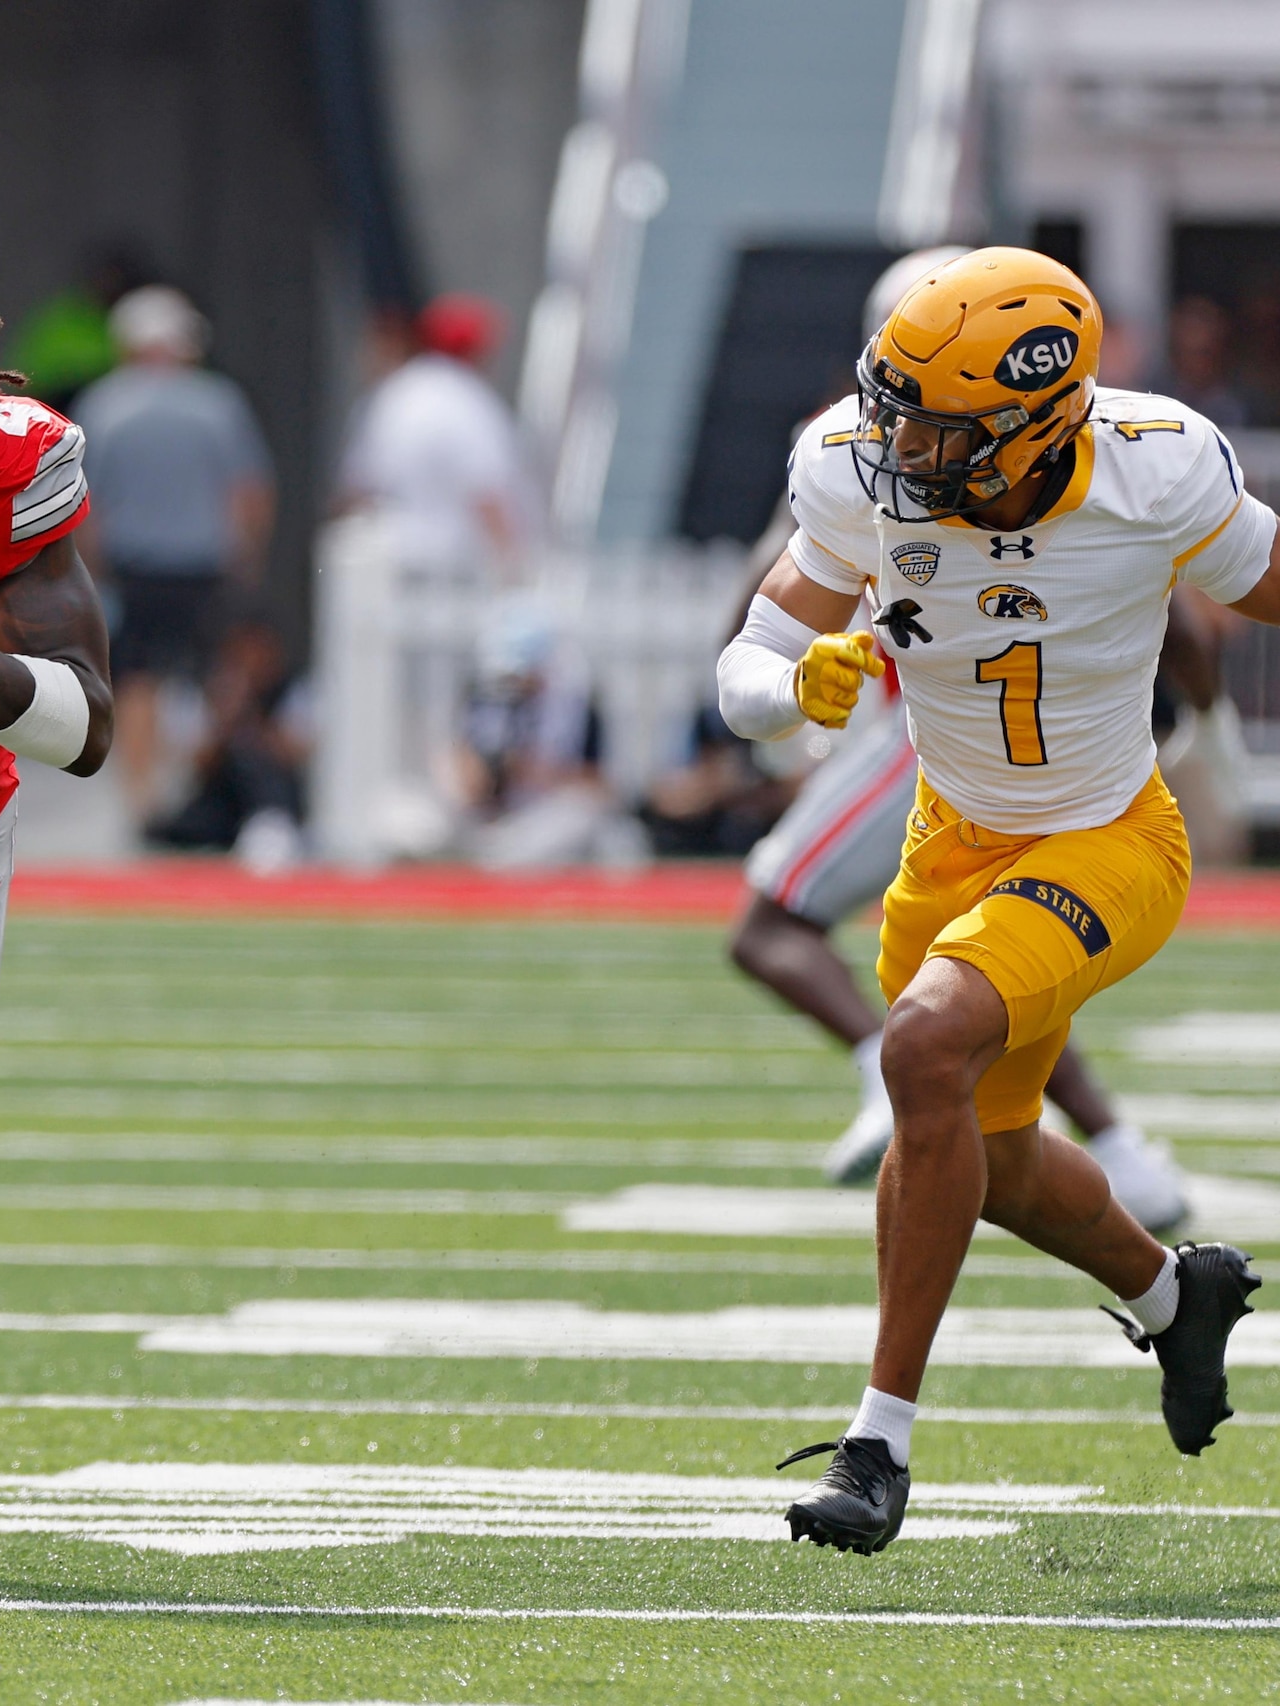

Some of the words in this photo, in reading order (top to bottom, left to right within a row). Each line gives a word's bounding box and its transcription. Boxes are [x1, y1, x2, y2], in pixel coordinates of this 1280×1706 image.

[1006, 336, 1073, 381] KSU
[1114, 420, 1185, 443] 1
[897, 543, 933, 555] GRADUATE
[900, 563, 937, 575] MAC
[994, 593, 1029, 619] K
[975, 640, 1048, 766] 1
[1035, 884, 1092, 937] STATE
